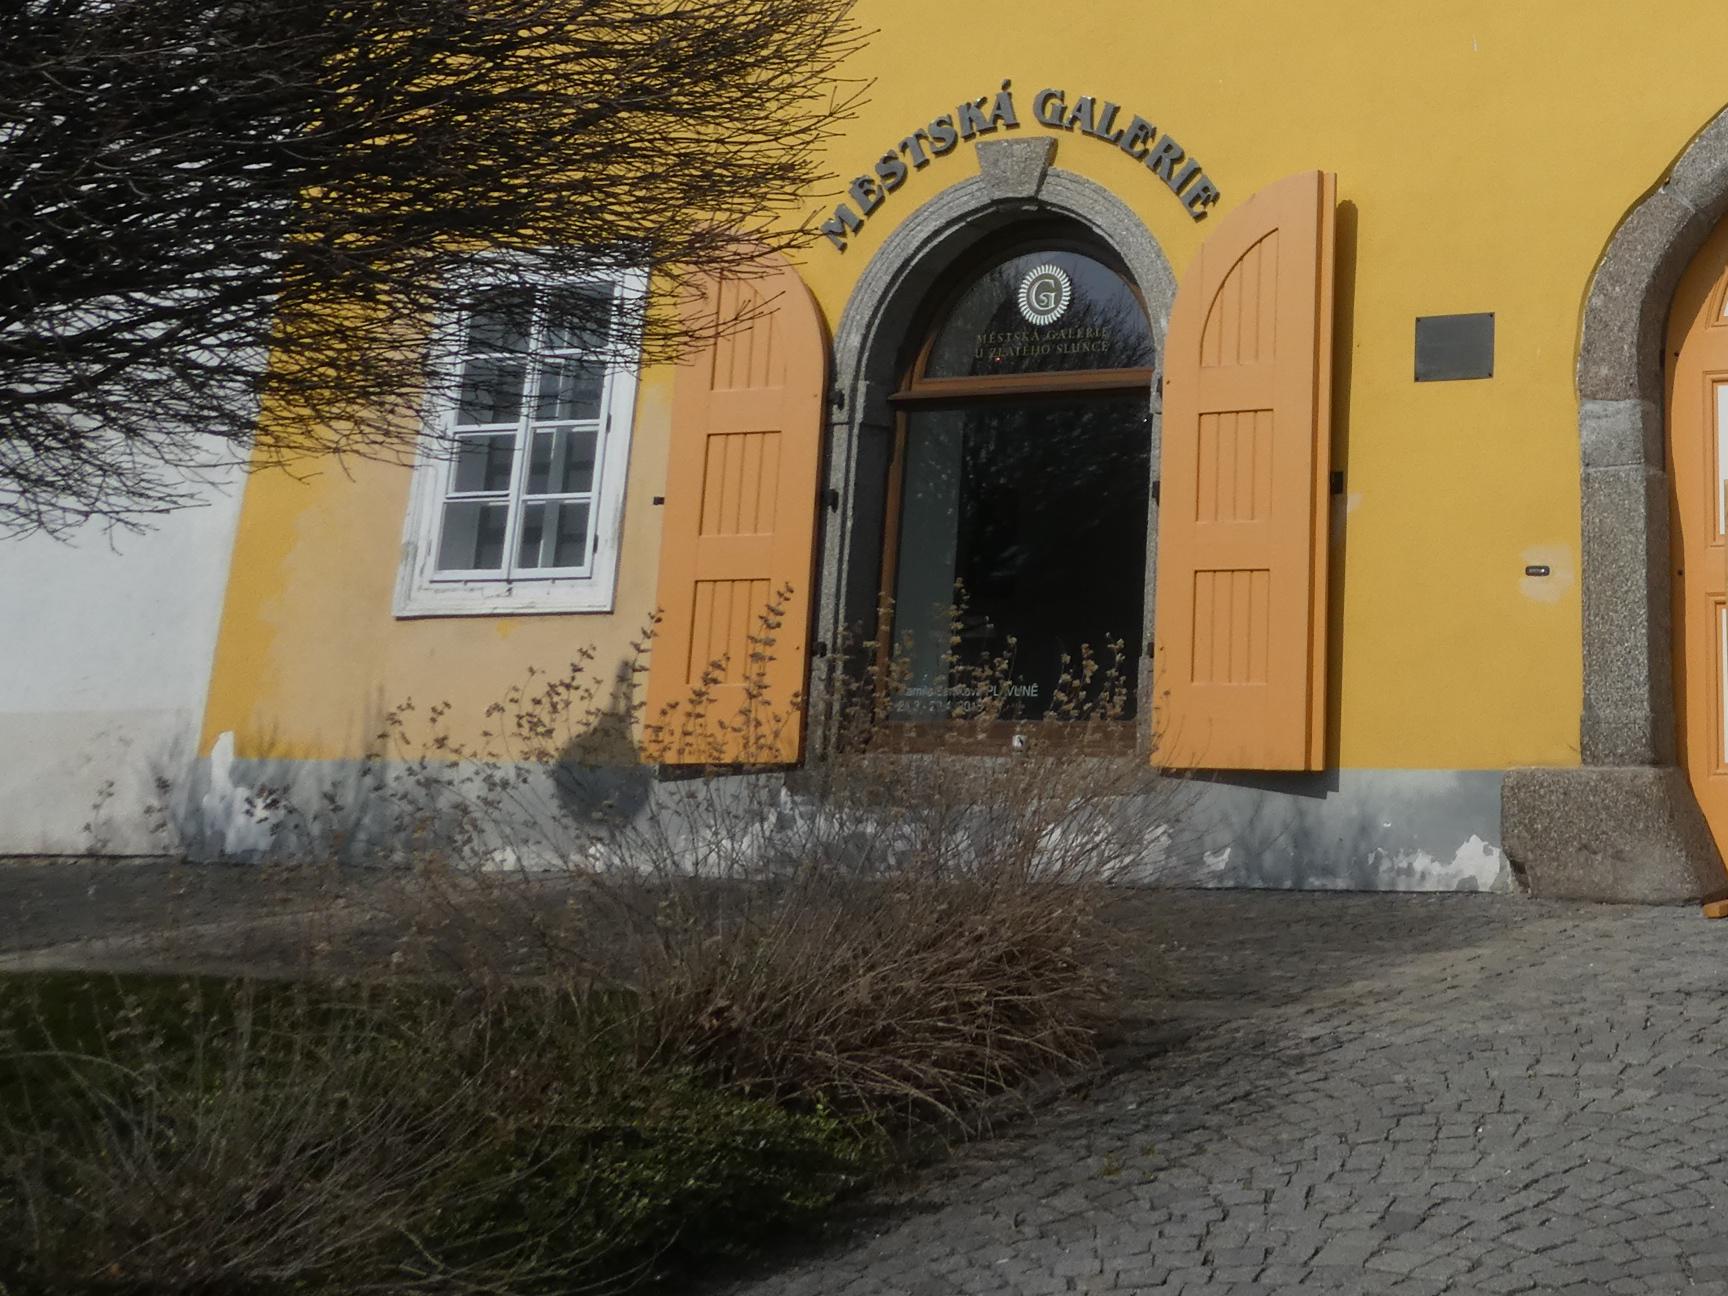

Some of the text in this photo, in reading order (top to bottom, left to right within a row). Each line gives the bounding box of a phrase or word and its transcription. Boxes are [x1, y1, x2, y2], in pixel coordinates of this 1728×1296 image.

[820, 78, 1221, 253] MĚSTSKÁ GALERIE
[1030, 279, 1057, 310] G
[1046, 326, 1110, 340] GALERIE
[1055, 340, 1110, 354] SLUNCE
[987, 683, 1040, 697] PLVUNĚ
